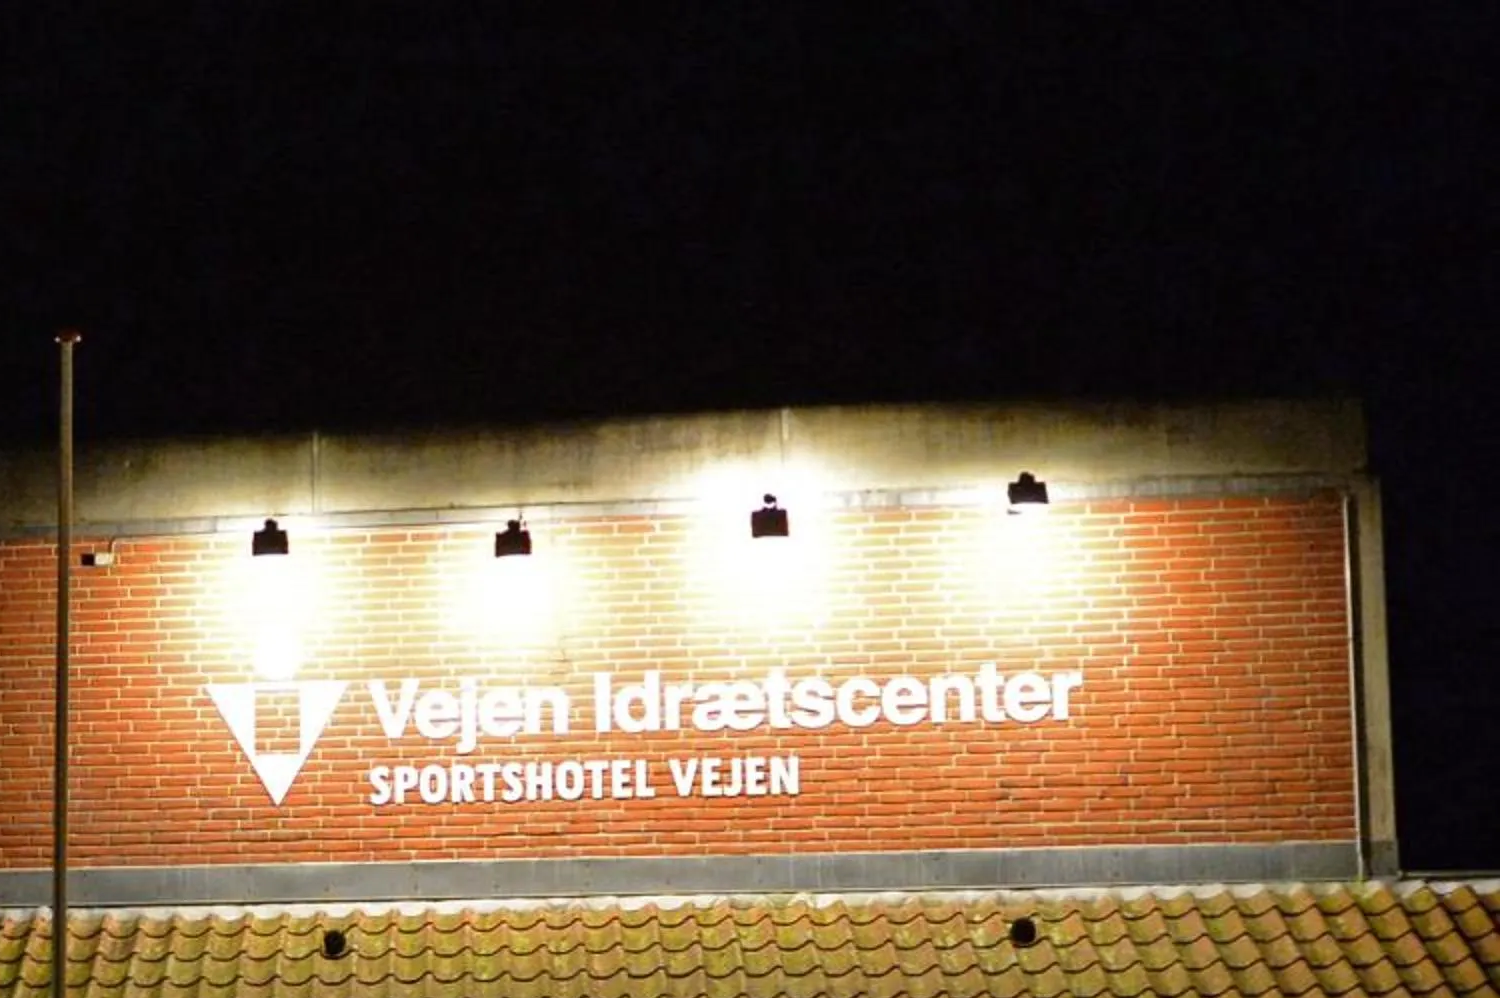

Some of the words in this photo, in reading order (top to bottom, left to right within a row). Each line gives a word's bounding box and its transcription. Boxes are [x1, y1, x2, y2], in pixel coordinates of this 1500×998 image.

[368, 676, 570, 755] Vejen
[594, 662, 1083, 734] Idrætscenter
[368, 758, 656, 806] SPORTSHOTEL
[668, 756, 800, 798] VEJEN
